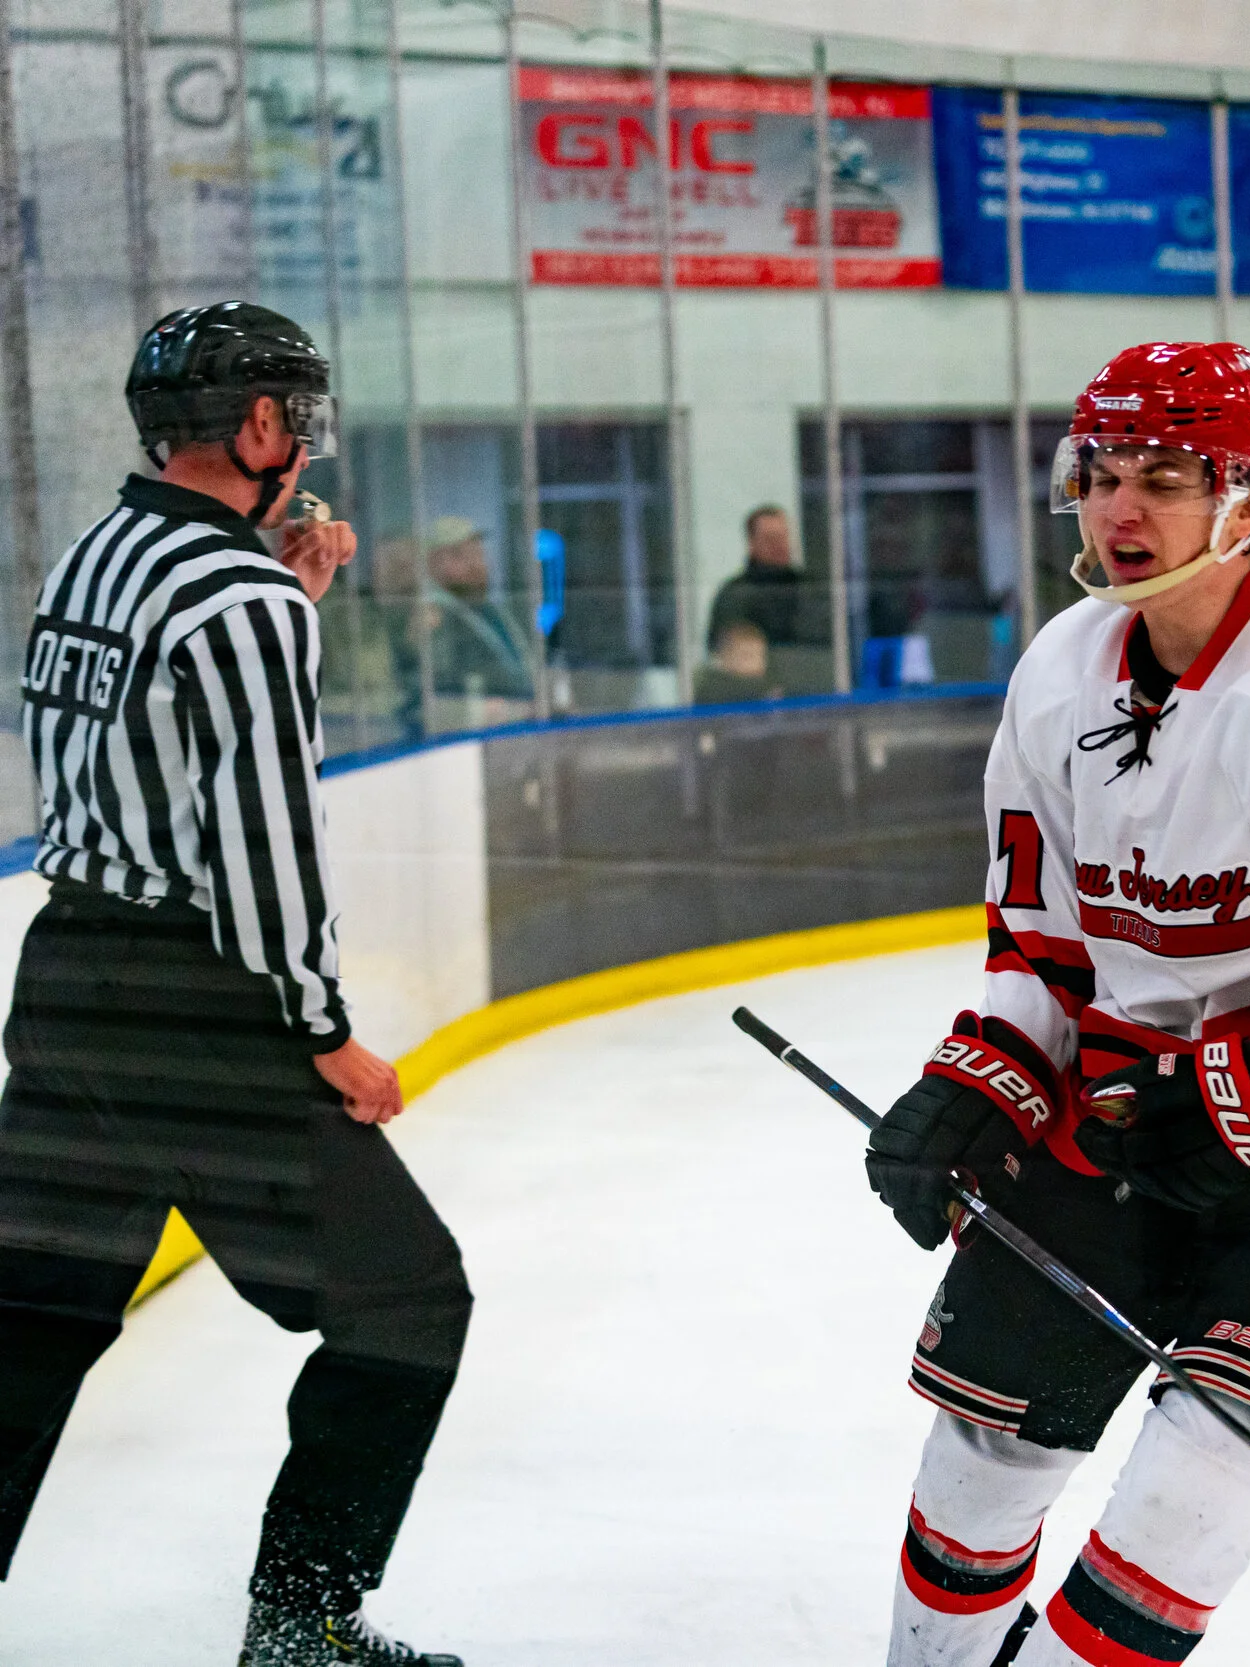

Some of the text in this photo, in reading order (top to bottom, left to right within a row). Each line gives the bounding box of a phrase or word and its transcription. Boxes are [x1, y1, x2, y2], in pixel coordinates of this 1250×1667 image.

[534, 112, 757, 175] GNC
[21, 629, 123, 709] OFTIS
[1110, 912, 1161, 947] TITANS
